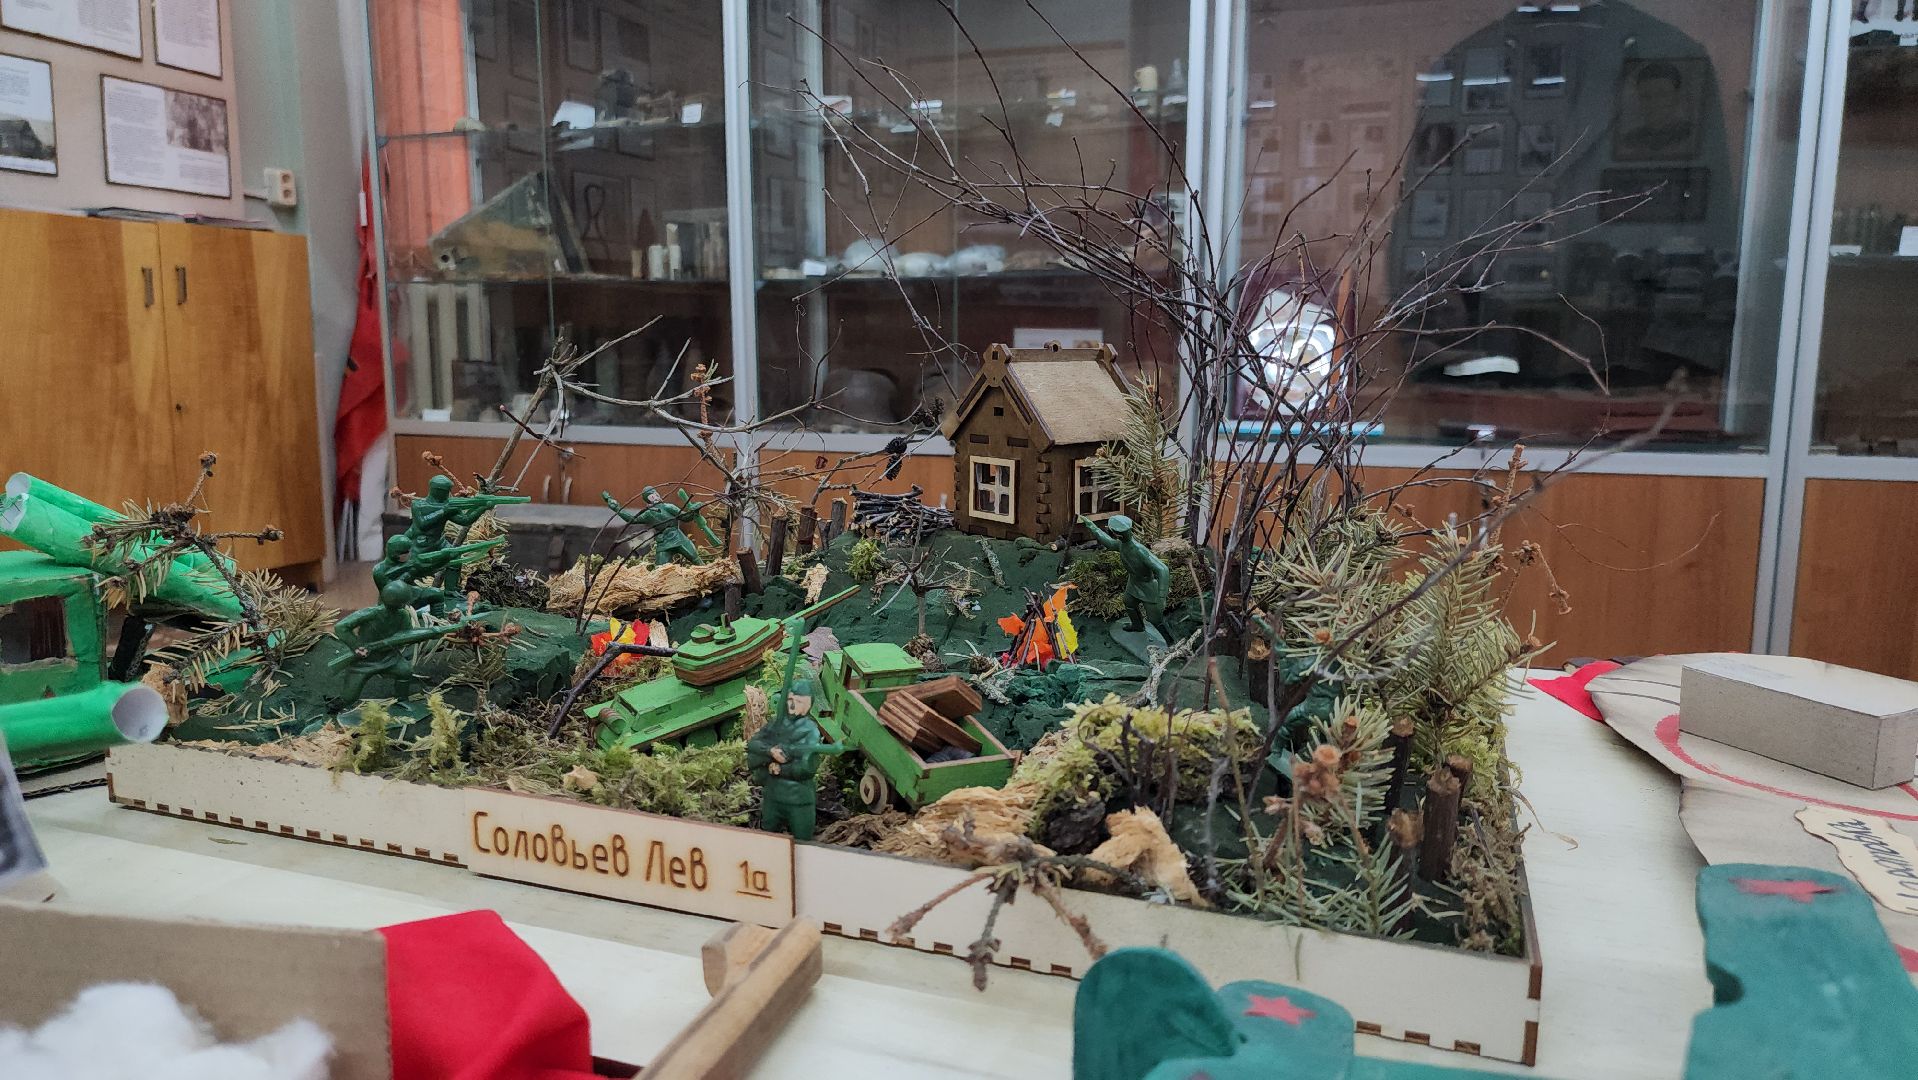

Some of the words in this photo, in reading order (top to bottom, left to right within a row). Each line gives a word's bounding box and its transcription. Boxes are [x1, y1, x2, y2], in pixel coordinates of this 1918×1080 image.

[473, 811, 630, 877] Соловьев
[645, 840, 708, 891] Лев
[739, 860, 770, 891] 1а
